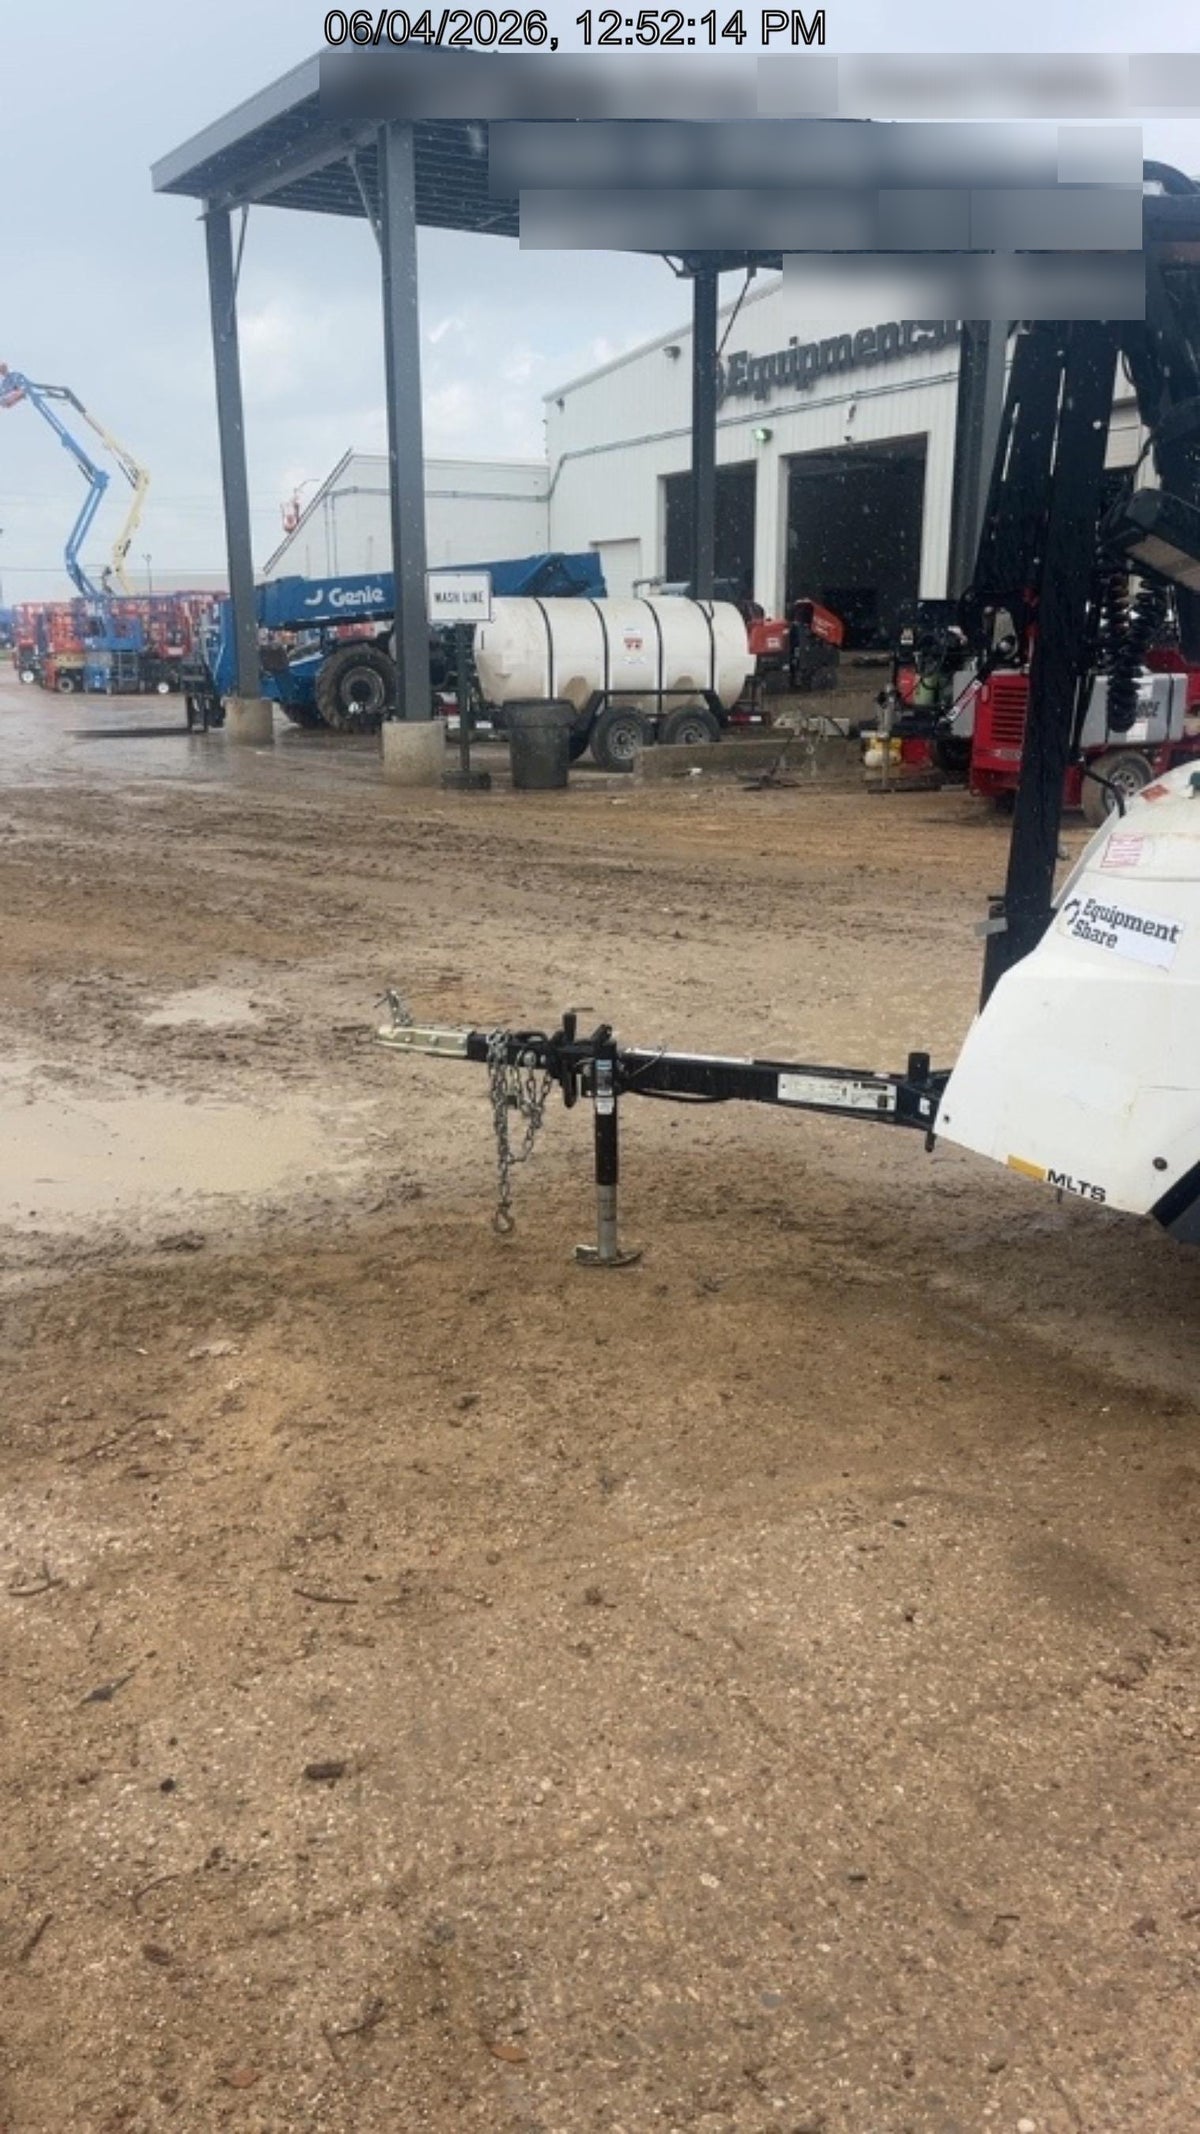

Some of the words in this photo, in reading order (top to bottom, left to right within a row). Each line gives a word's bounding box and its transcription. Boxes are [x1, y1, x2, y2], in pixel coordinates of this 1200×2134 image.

[329, 585, 385, 607] Genie
[434, 592, 460, 603] WASH
[1072, 919, 1118, 948] Share
[1083, 898, 1179, 944] Equipment
